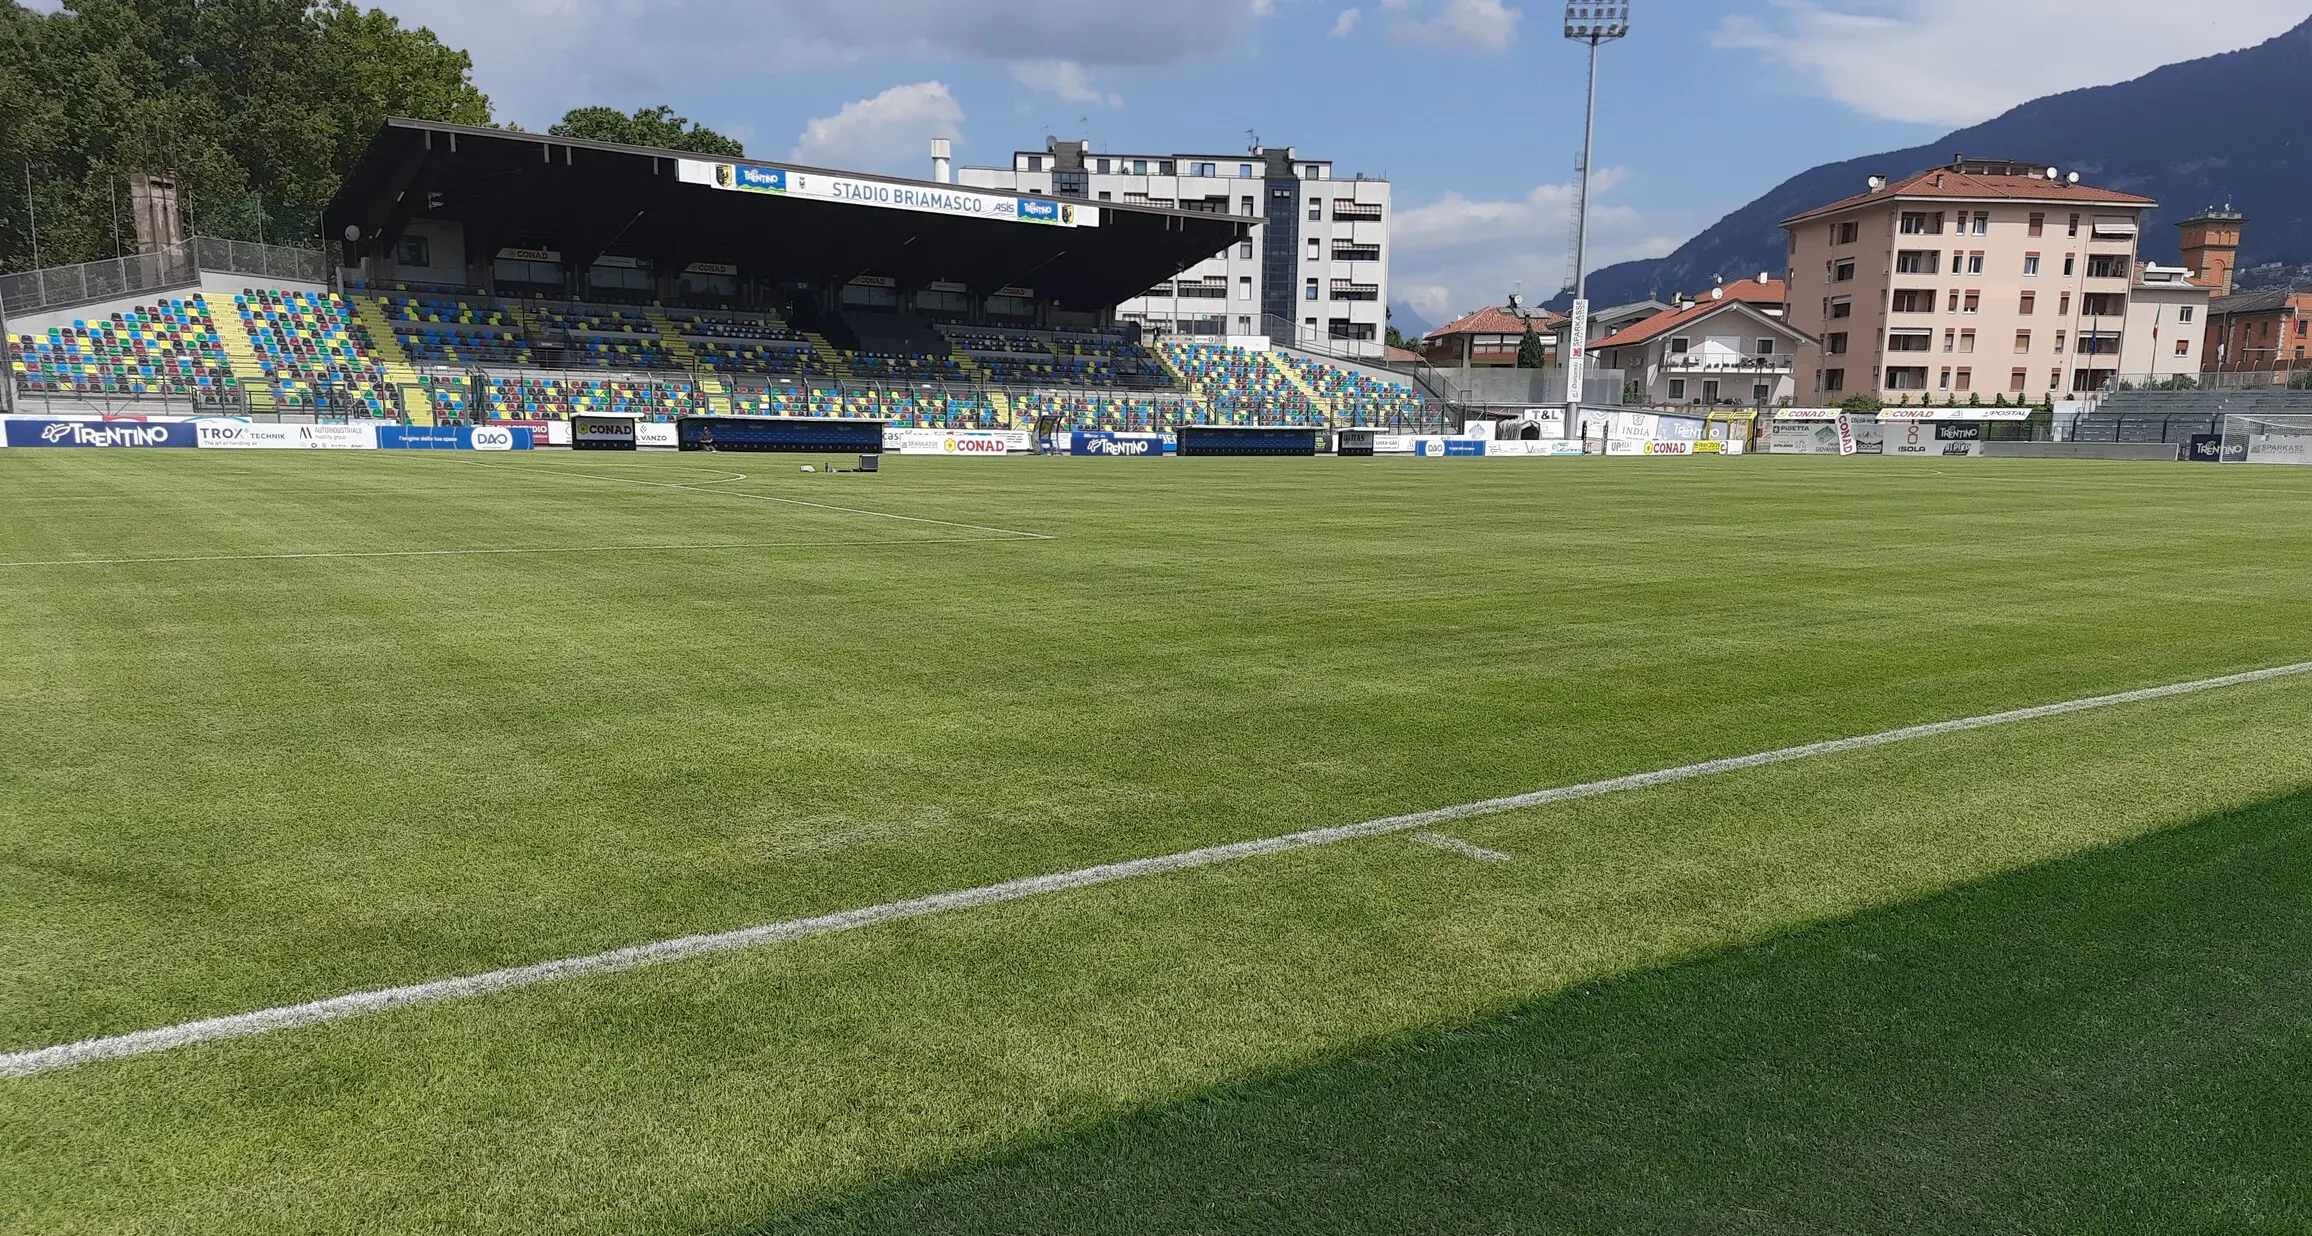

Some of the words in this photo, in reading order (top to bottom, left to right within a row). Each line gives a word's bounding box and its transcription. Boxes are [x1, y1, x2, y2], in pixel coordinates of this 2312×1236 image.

[743, 169, 779, 184] TRENTINO
[832, 182, 889, 202] STADIO
[894, 189, 982, 212] BRIAMASCO
[1023, 202, 1052, 215] TRENTINO
[517, 250, 548, 260] CONAD
[698, 264, 726, 273] CONAD
[860, 276, 886, 285] CONAD
[1572, 301, 1583, 347] SPARKASSE
[1788, 410, 1826, 418] CONAD
[1892, 410, 1934, 418] CONAD
[69, 423, 168, 447] TRENTINO
[199, 428, 244, 439] TROX
[589, 425, 632, 435] CONAD
[1622, 426, 1650, 437] INDIA
[1674, 423, 1719, 440] TRENTO
[1838, 415, 1853, 453] CONAD
[1940, 427, 1978, 439] TRENTINO
[477, 433, 508, 445] DAO
[957, 440, 1005, 452] CONAD
[1101, 439, 1148, 455] TRENTINO
[1653, 442, 1686, 454] CONAD
